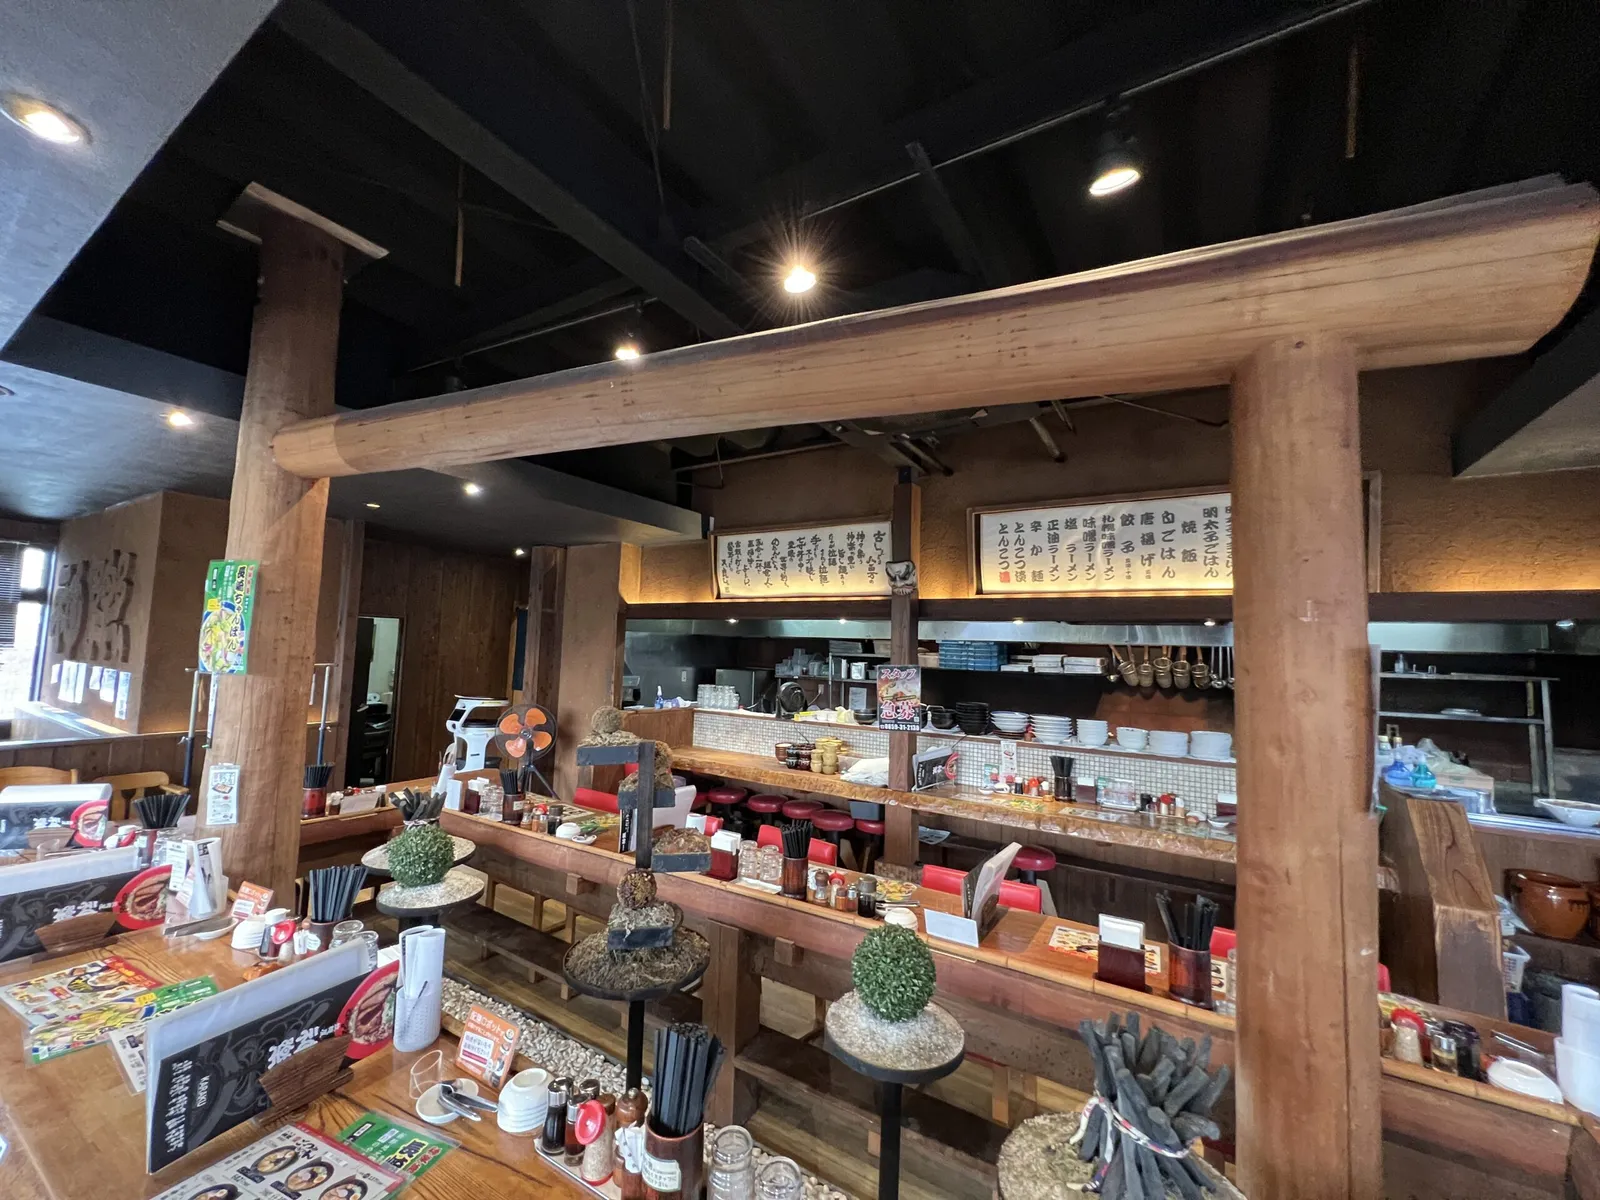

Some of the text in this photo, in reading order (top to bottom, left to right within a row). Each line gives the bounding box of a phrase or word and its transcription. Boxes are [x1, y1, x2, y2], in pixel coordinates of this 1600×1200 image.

[1047, 519, 1060, 582] 正油ラーメン
[1064, 517, 1078, 582] 塩ラーメン
[1082, 516, 1097, 581] 味噌ラーメン
[1101, 515, 1116, 581] 札幌味噌ラーメン
[1120, 514, 1135, 553] 餃子
[1140, 512, 1156, 566] 唐揚げ
[1160, 511, 1176, 578] 白ごはん
[1203, 507, 1219, 578] 明太子ごはん
[227, 565, 248, 652] 長崎ちゃんぽん
[881, 668, 917, 680] スタッフ
[879, 699, 915, 721] 急募
[196, 1075, 210, 1108] KARAKU
